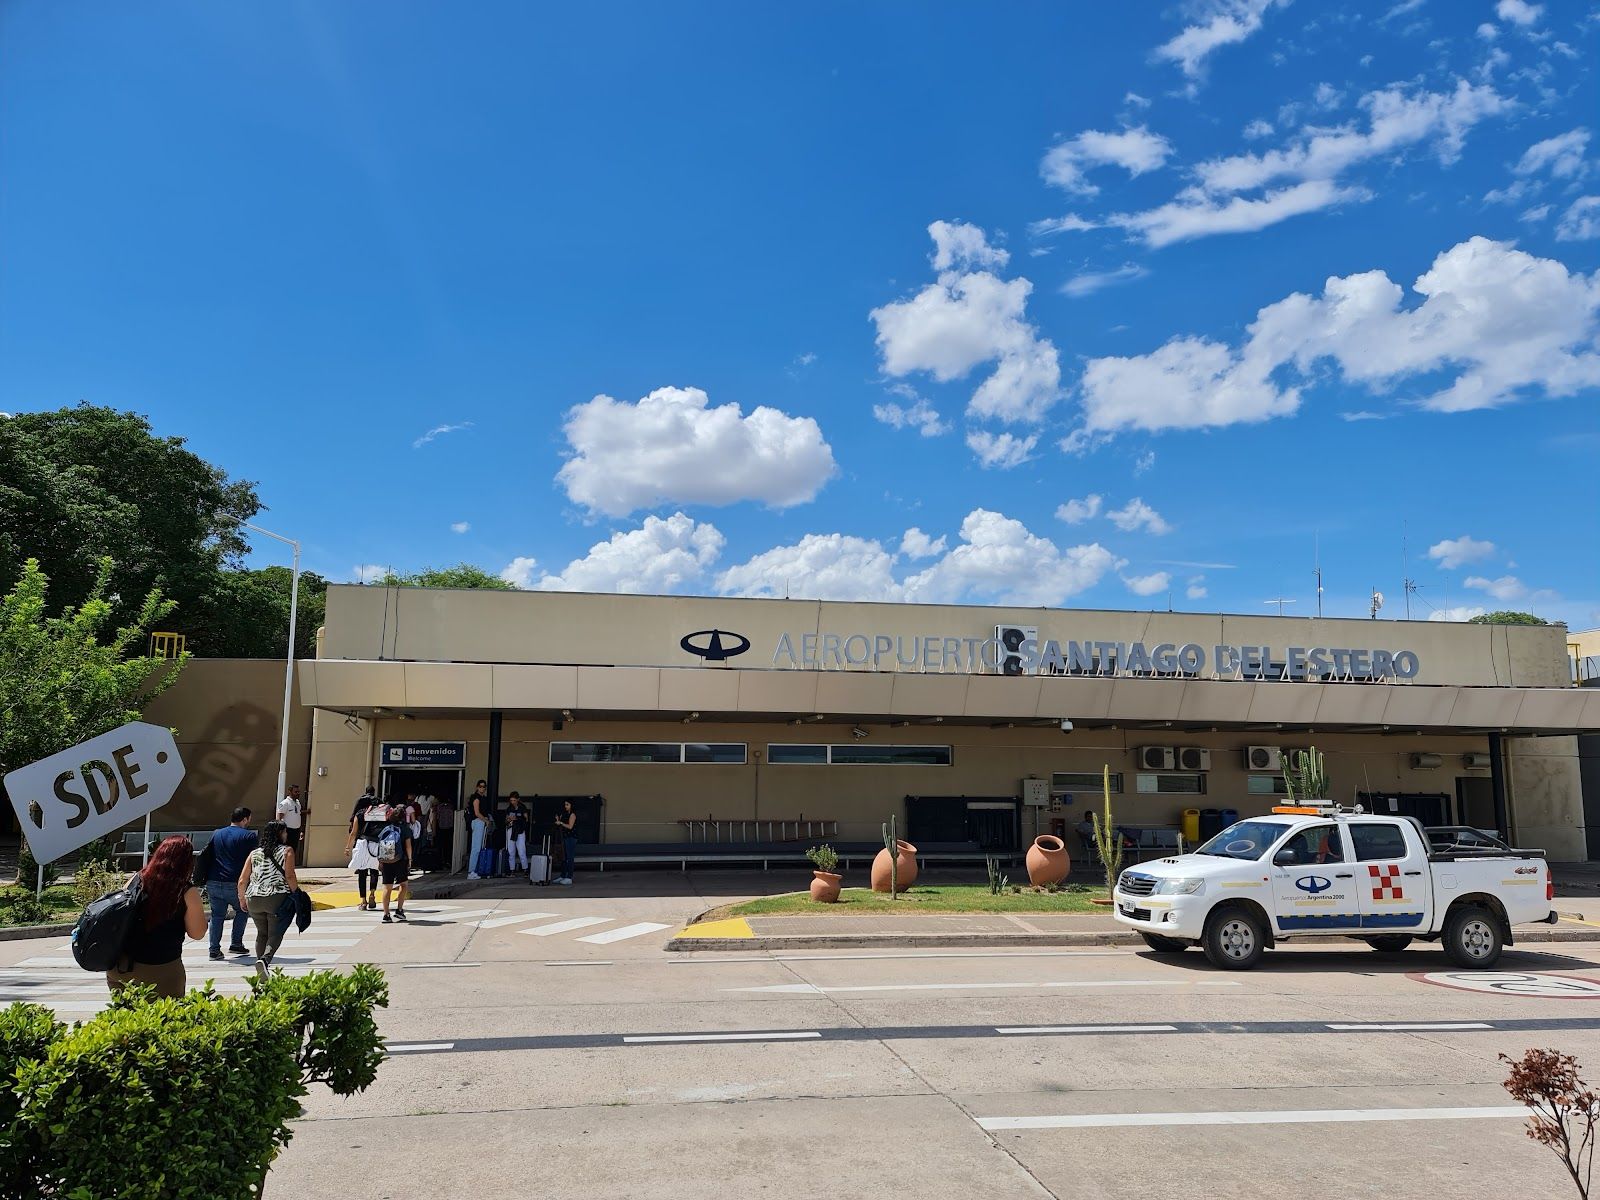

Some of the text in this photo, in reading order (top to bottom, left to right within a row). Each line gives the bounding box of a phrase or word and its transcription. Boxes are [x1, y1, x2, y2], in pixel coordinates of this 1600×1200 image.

[772, 632, 1420, 678] AEROPUERTO SANTIAGO DEL ESTERO
[407, 747, 457, 755] Bienvenidos
[53, 743, 149, 829] SDE
